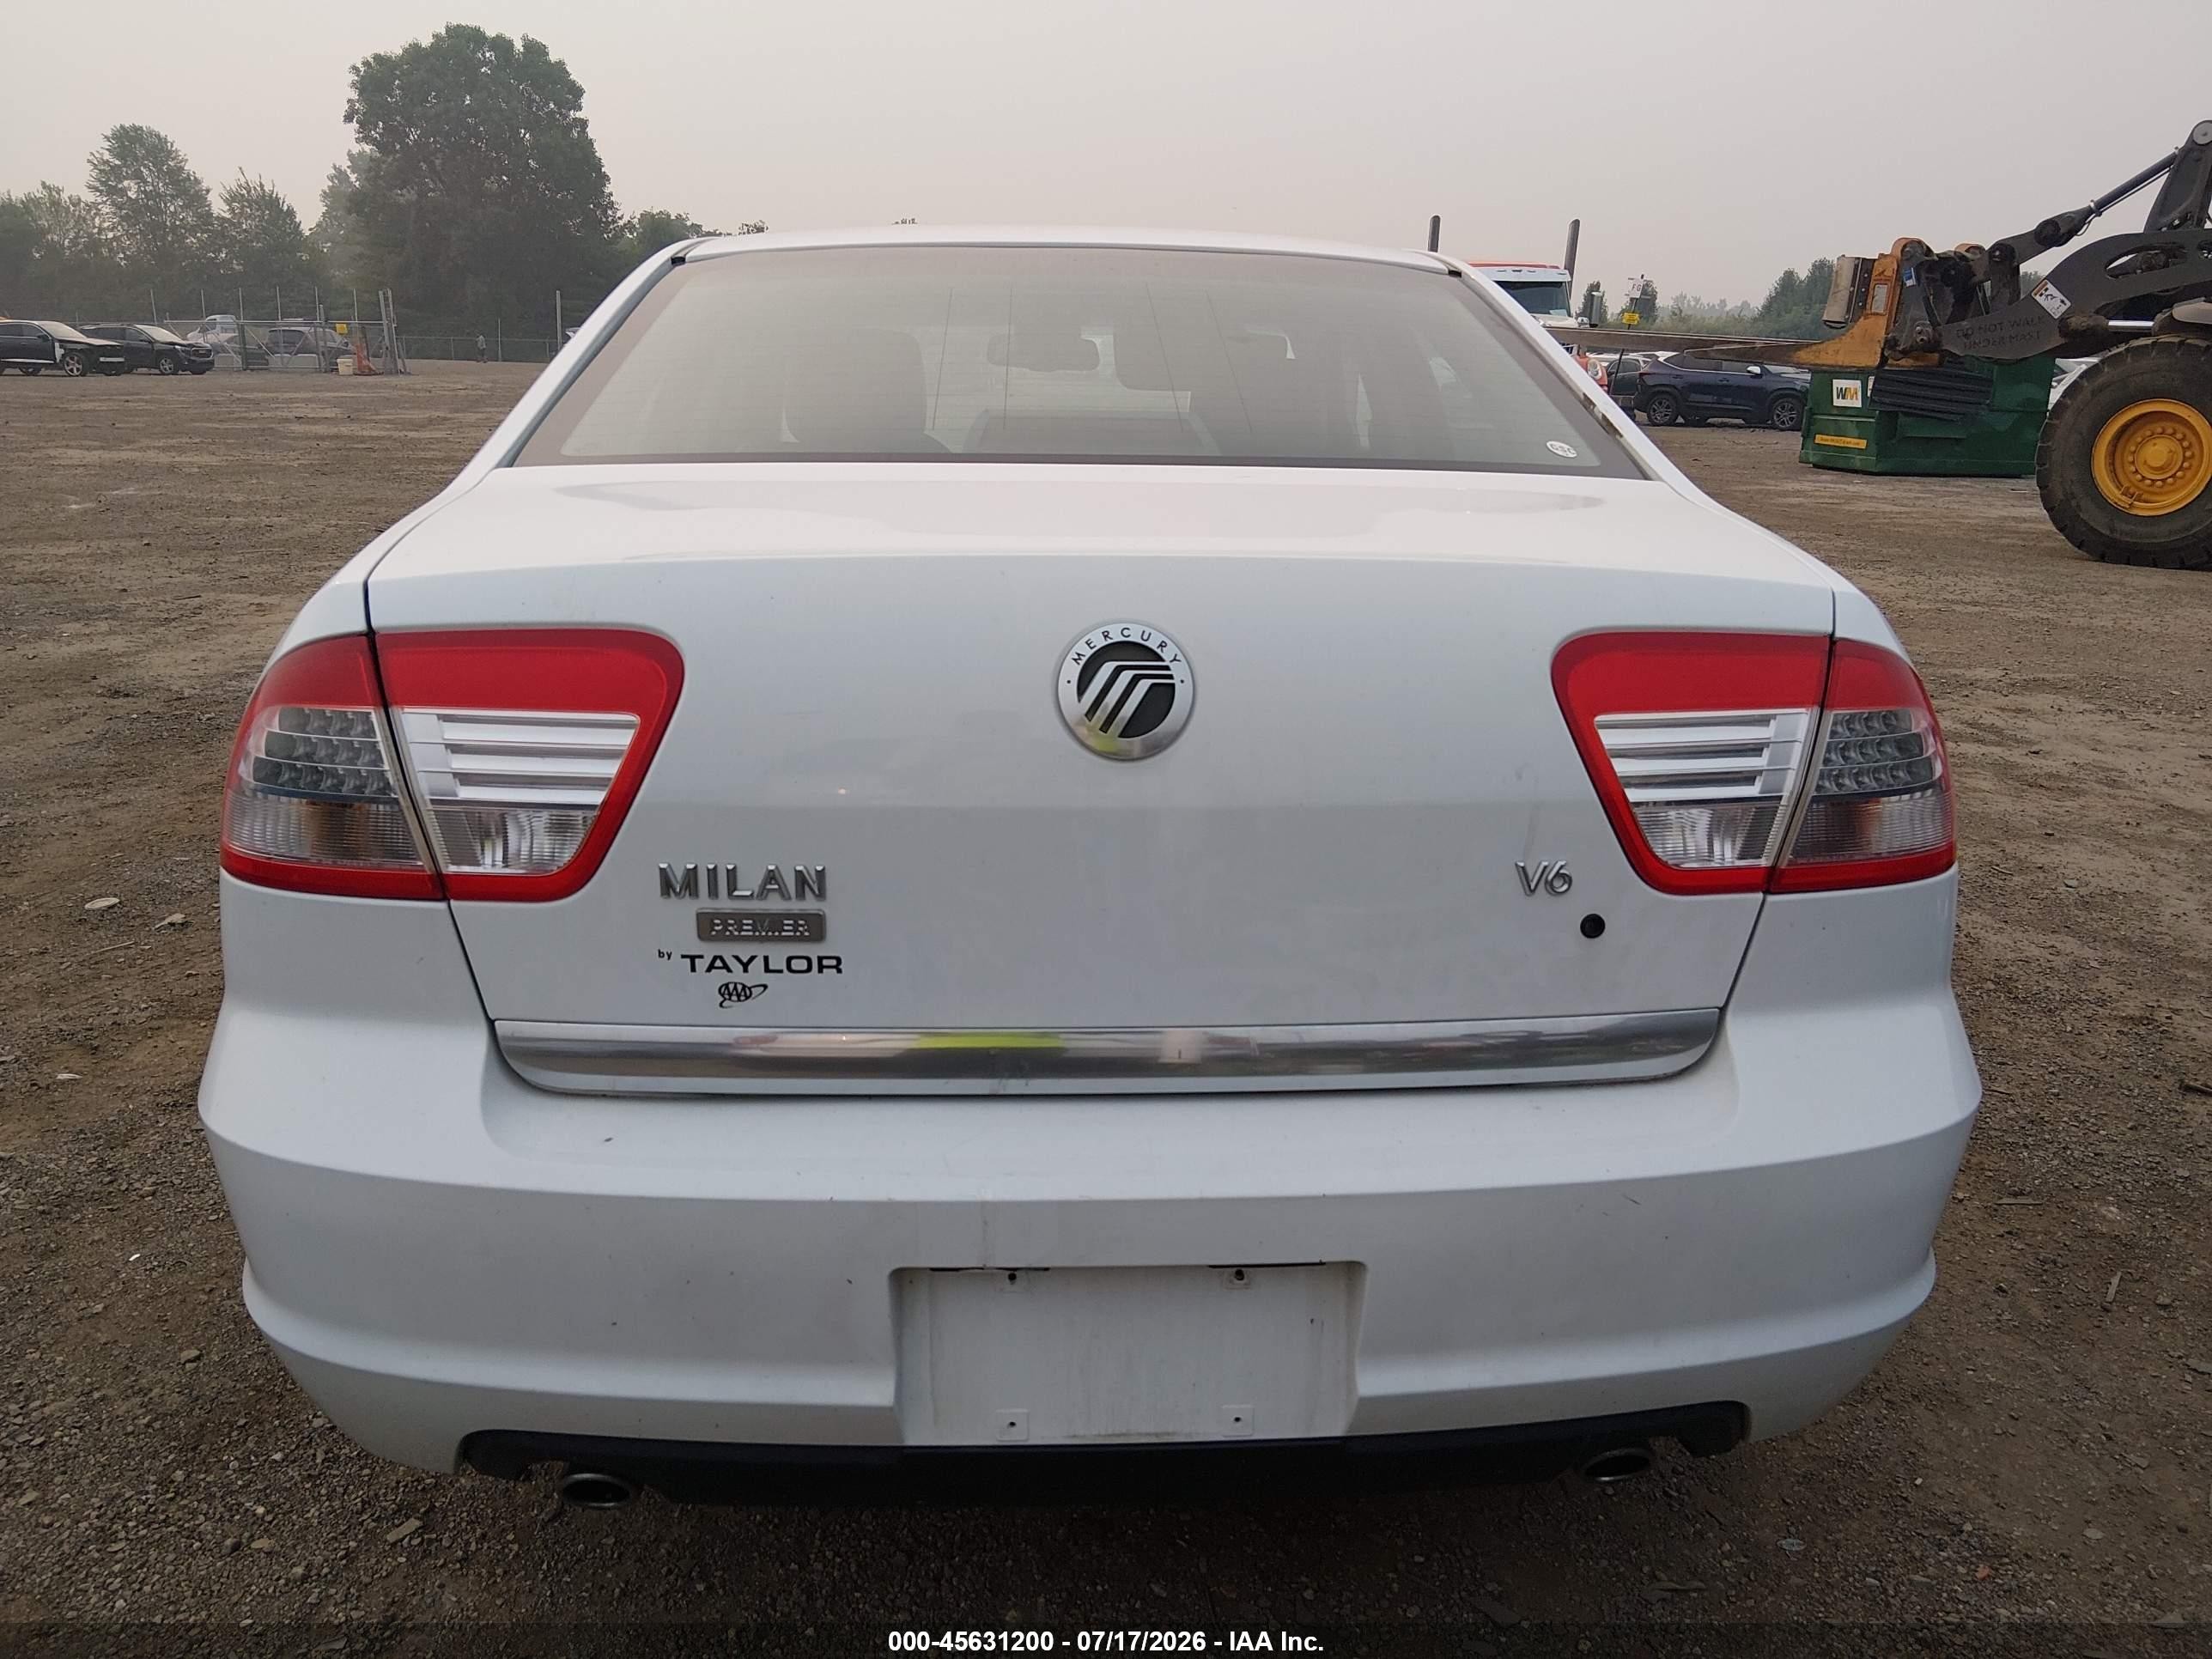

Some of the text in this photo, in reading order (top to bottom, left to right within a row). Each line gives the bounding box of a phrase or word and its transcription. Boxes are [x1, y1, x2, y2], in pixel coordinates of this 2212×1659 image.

[1978, 322, 2004, 333] NOT
[1835, 386, 1859, 401] WM
[1072, 627, 1182, 665] MERCURY
[658, 863, 827, 901] MILAN
[1515, 860, 1573, 896] V6
[711, 919, 811, 935] PREMIER
[658, 949, 843, 974] by TAYLOR
[720, 982, 751, 1001] AAA
